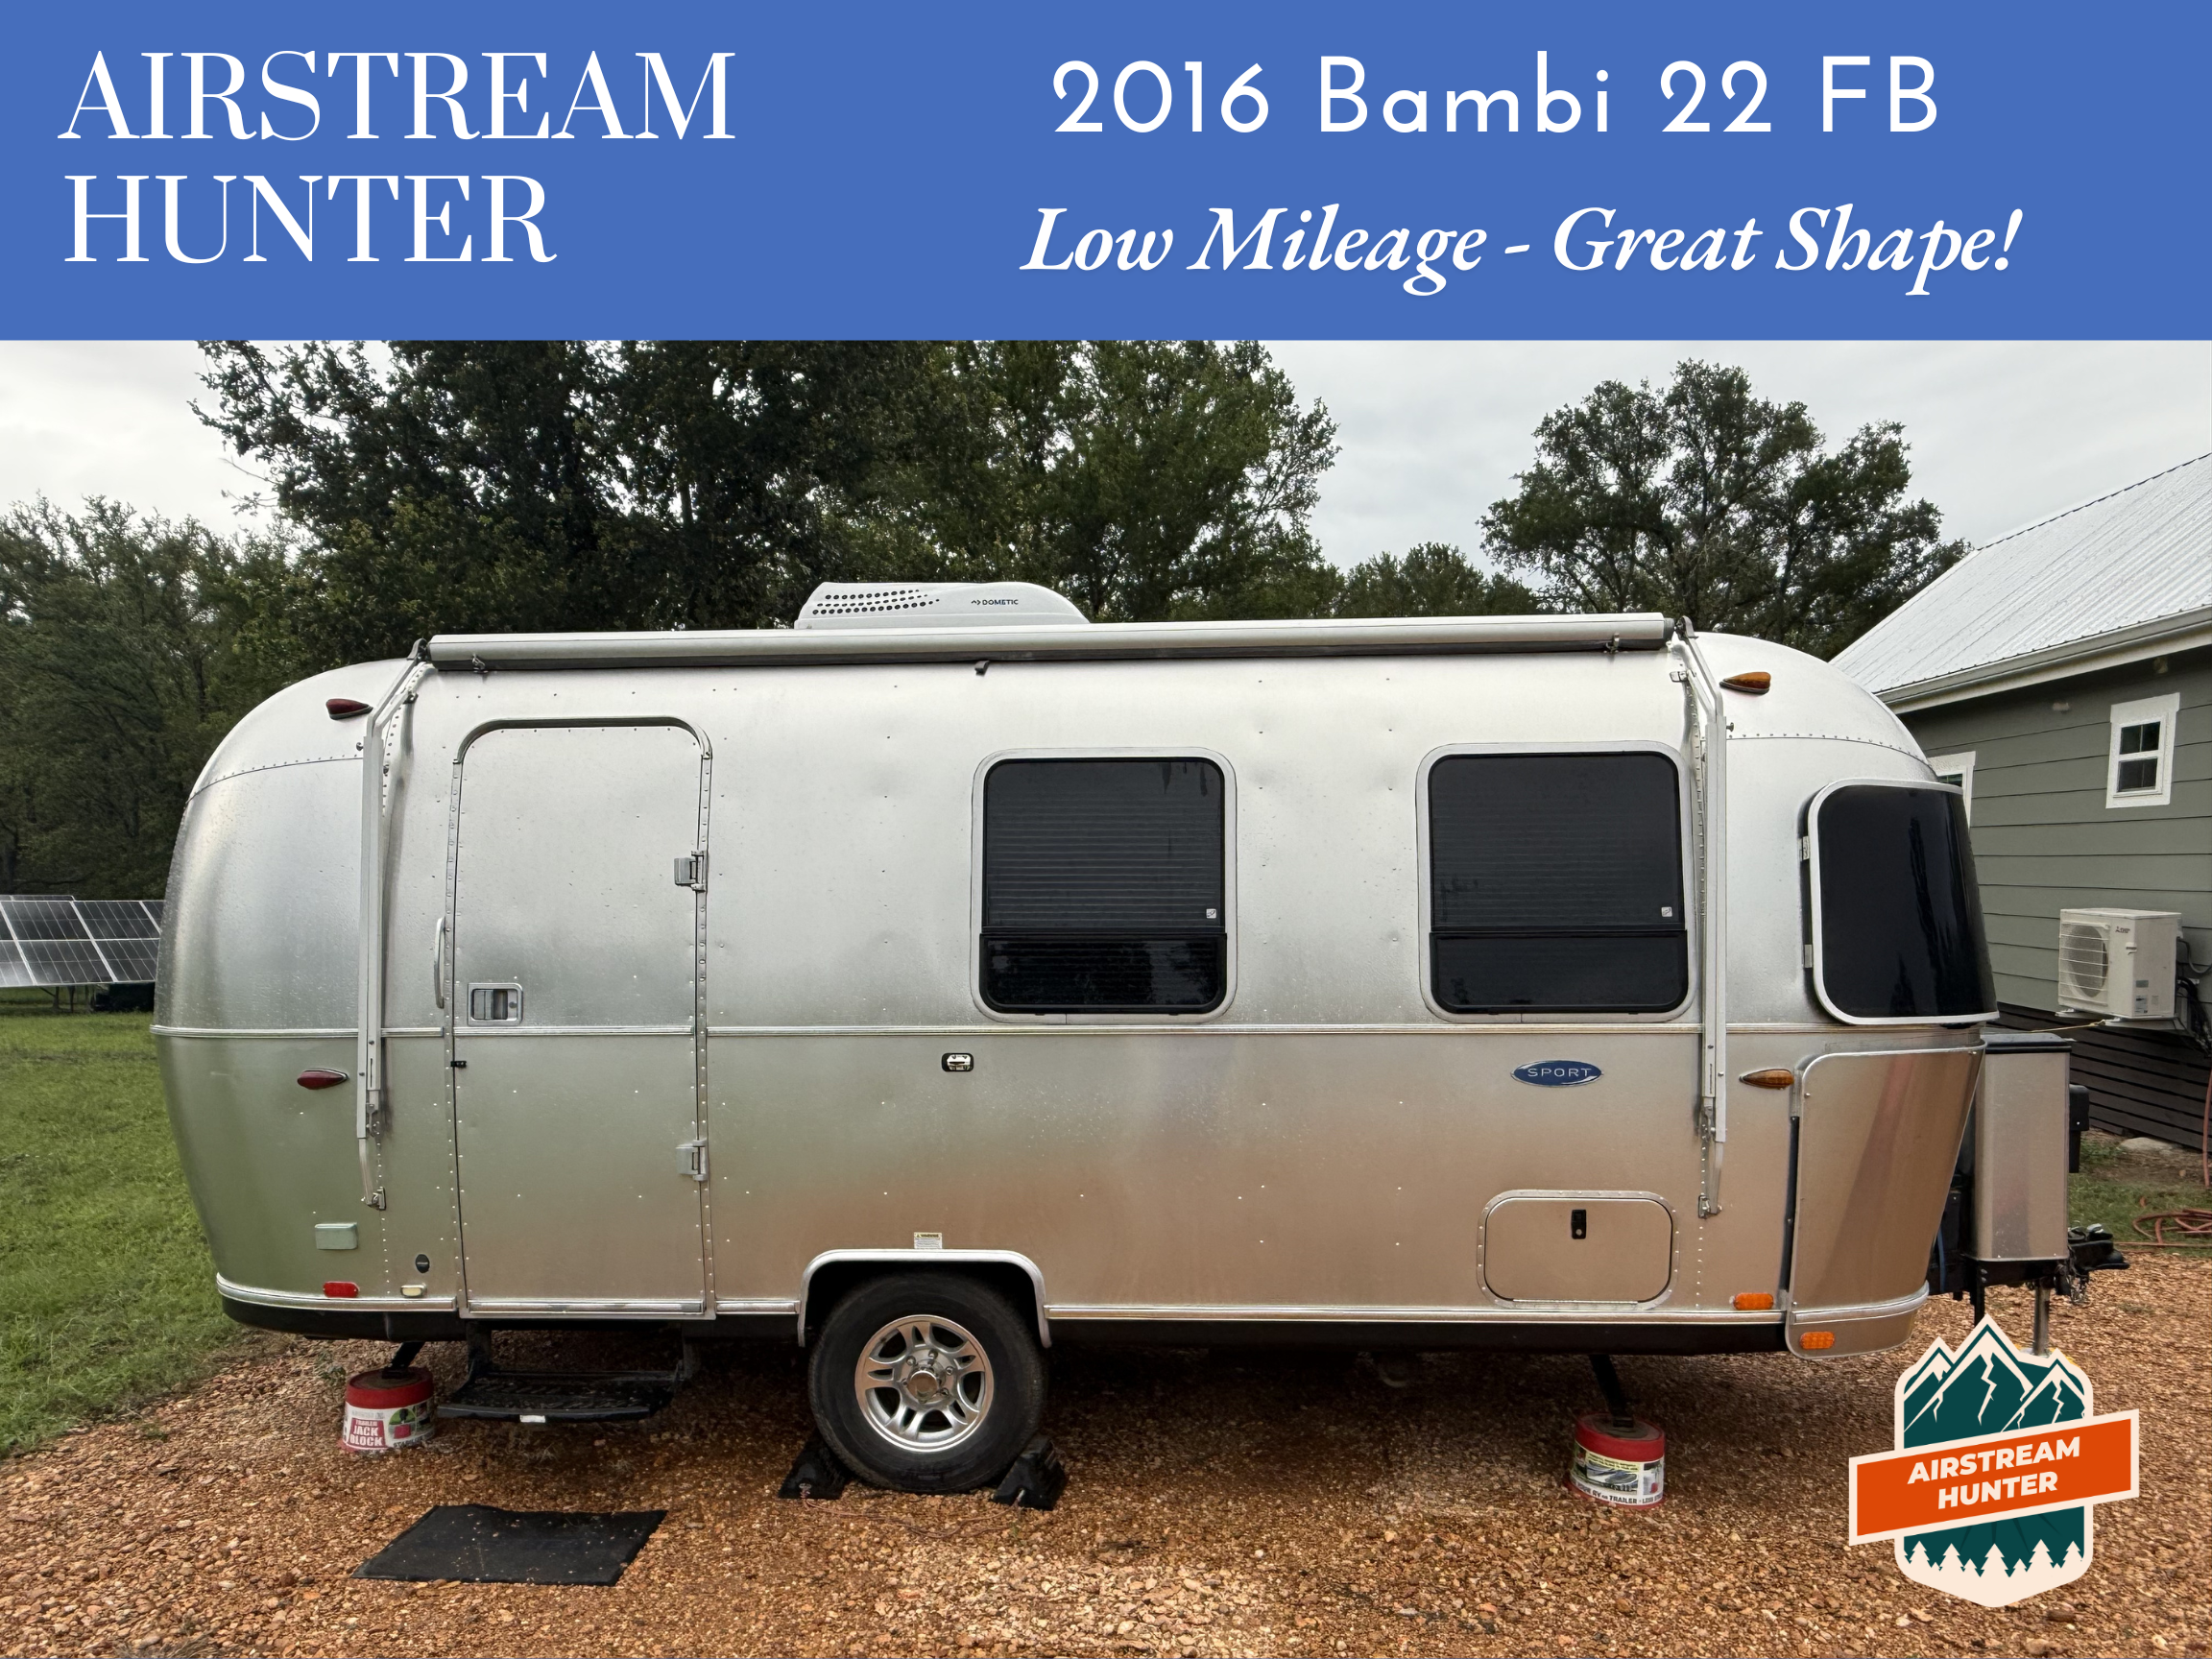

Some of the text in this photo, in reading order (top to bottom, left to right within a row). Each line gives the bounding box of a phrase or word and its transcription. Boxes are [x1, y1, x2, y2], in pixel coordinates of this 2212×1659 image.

[1527, 1068, 1592, 1077] SPORT
[353, 1426, 378, 1436] JACK
[349, 1434, 383, 1447] BLOCK
[1609, 1495, 1637, 1504] TRAILER
